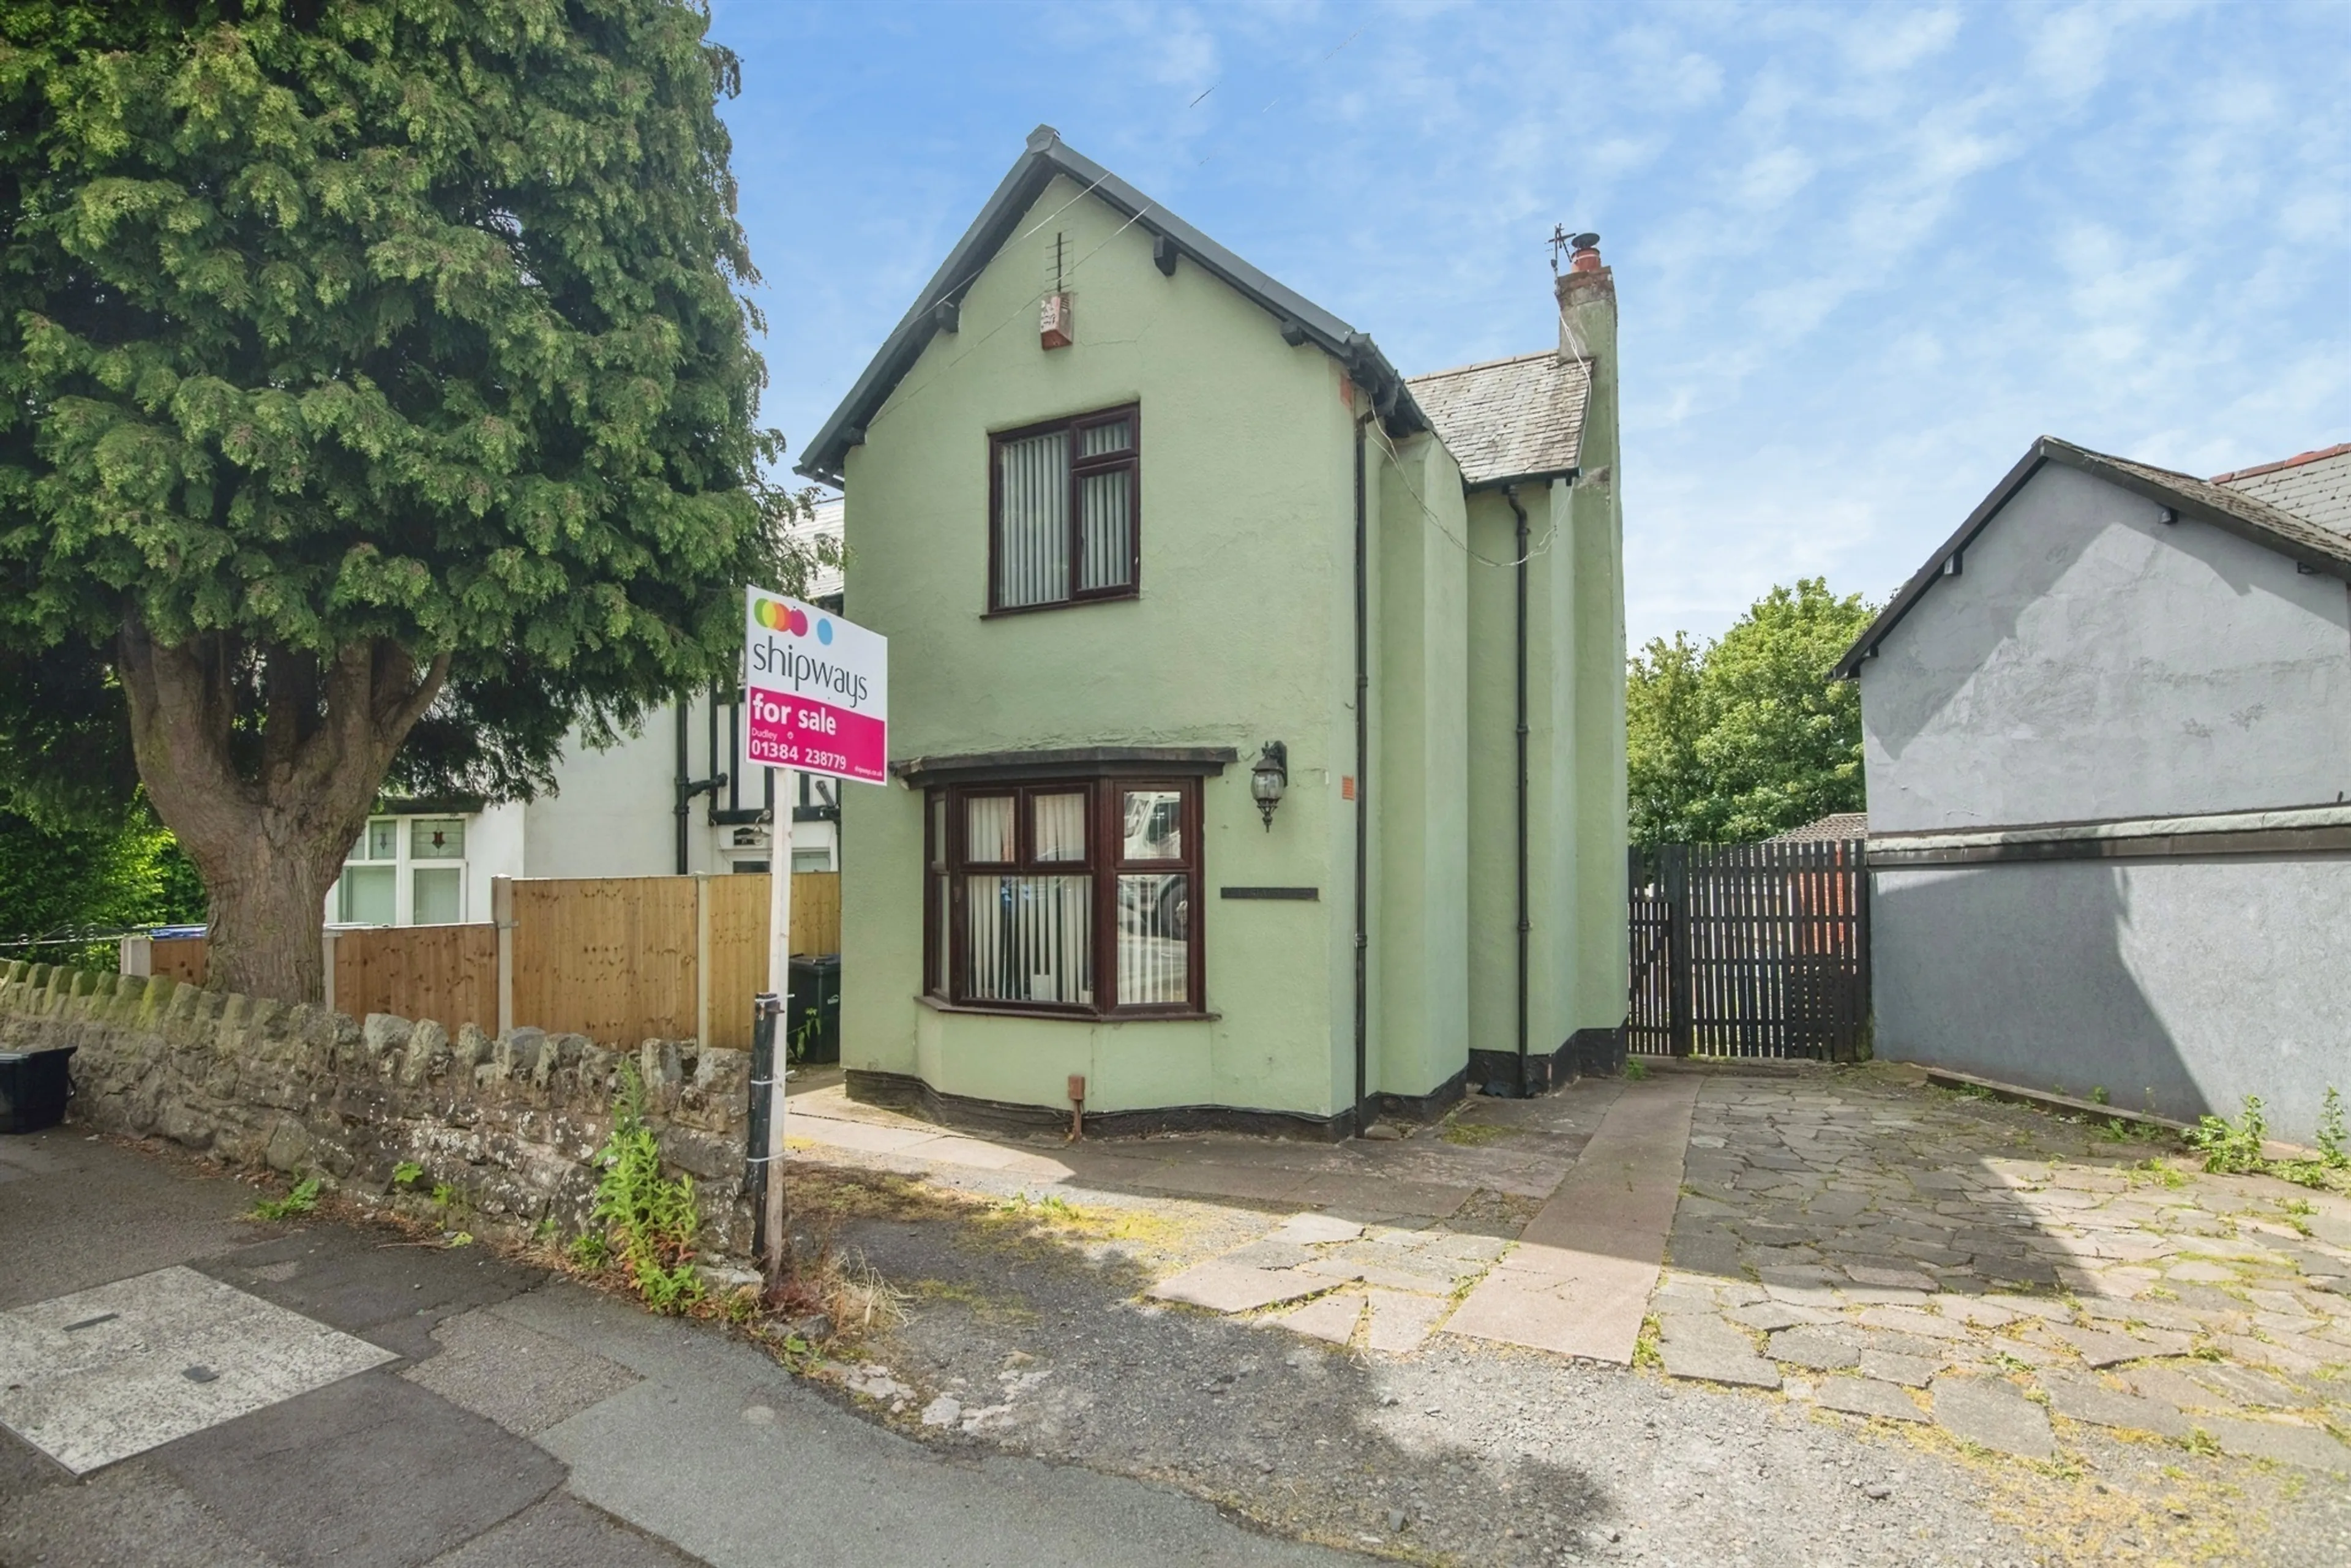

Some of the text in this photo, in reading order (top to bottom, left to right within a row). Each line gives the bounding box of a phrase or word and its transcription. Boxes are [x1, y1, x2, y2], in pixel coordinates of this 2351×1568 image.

[753, 635, 868, 708] shipways
[752, 692, 836, 735] for sale
[752, 727, 778, 741] Dudley
[752, 739, 847, 770] 01384 238779
